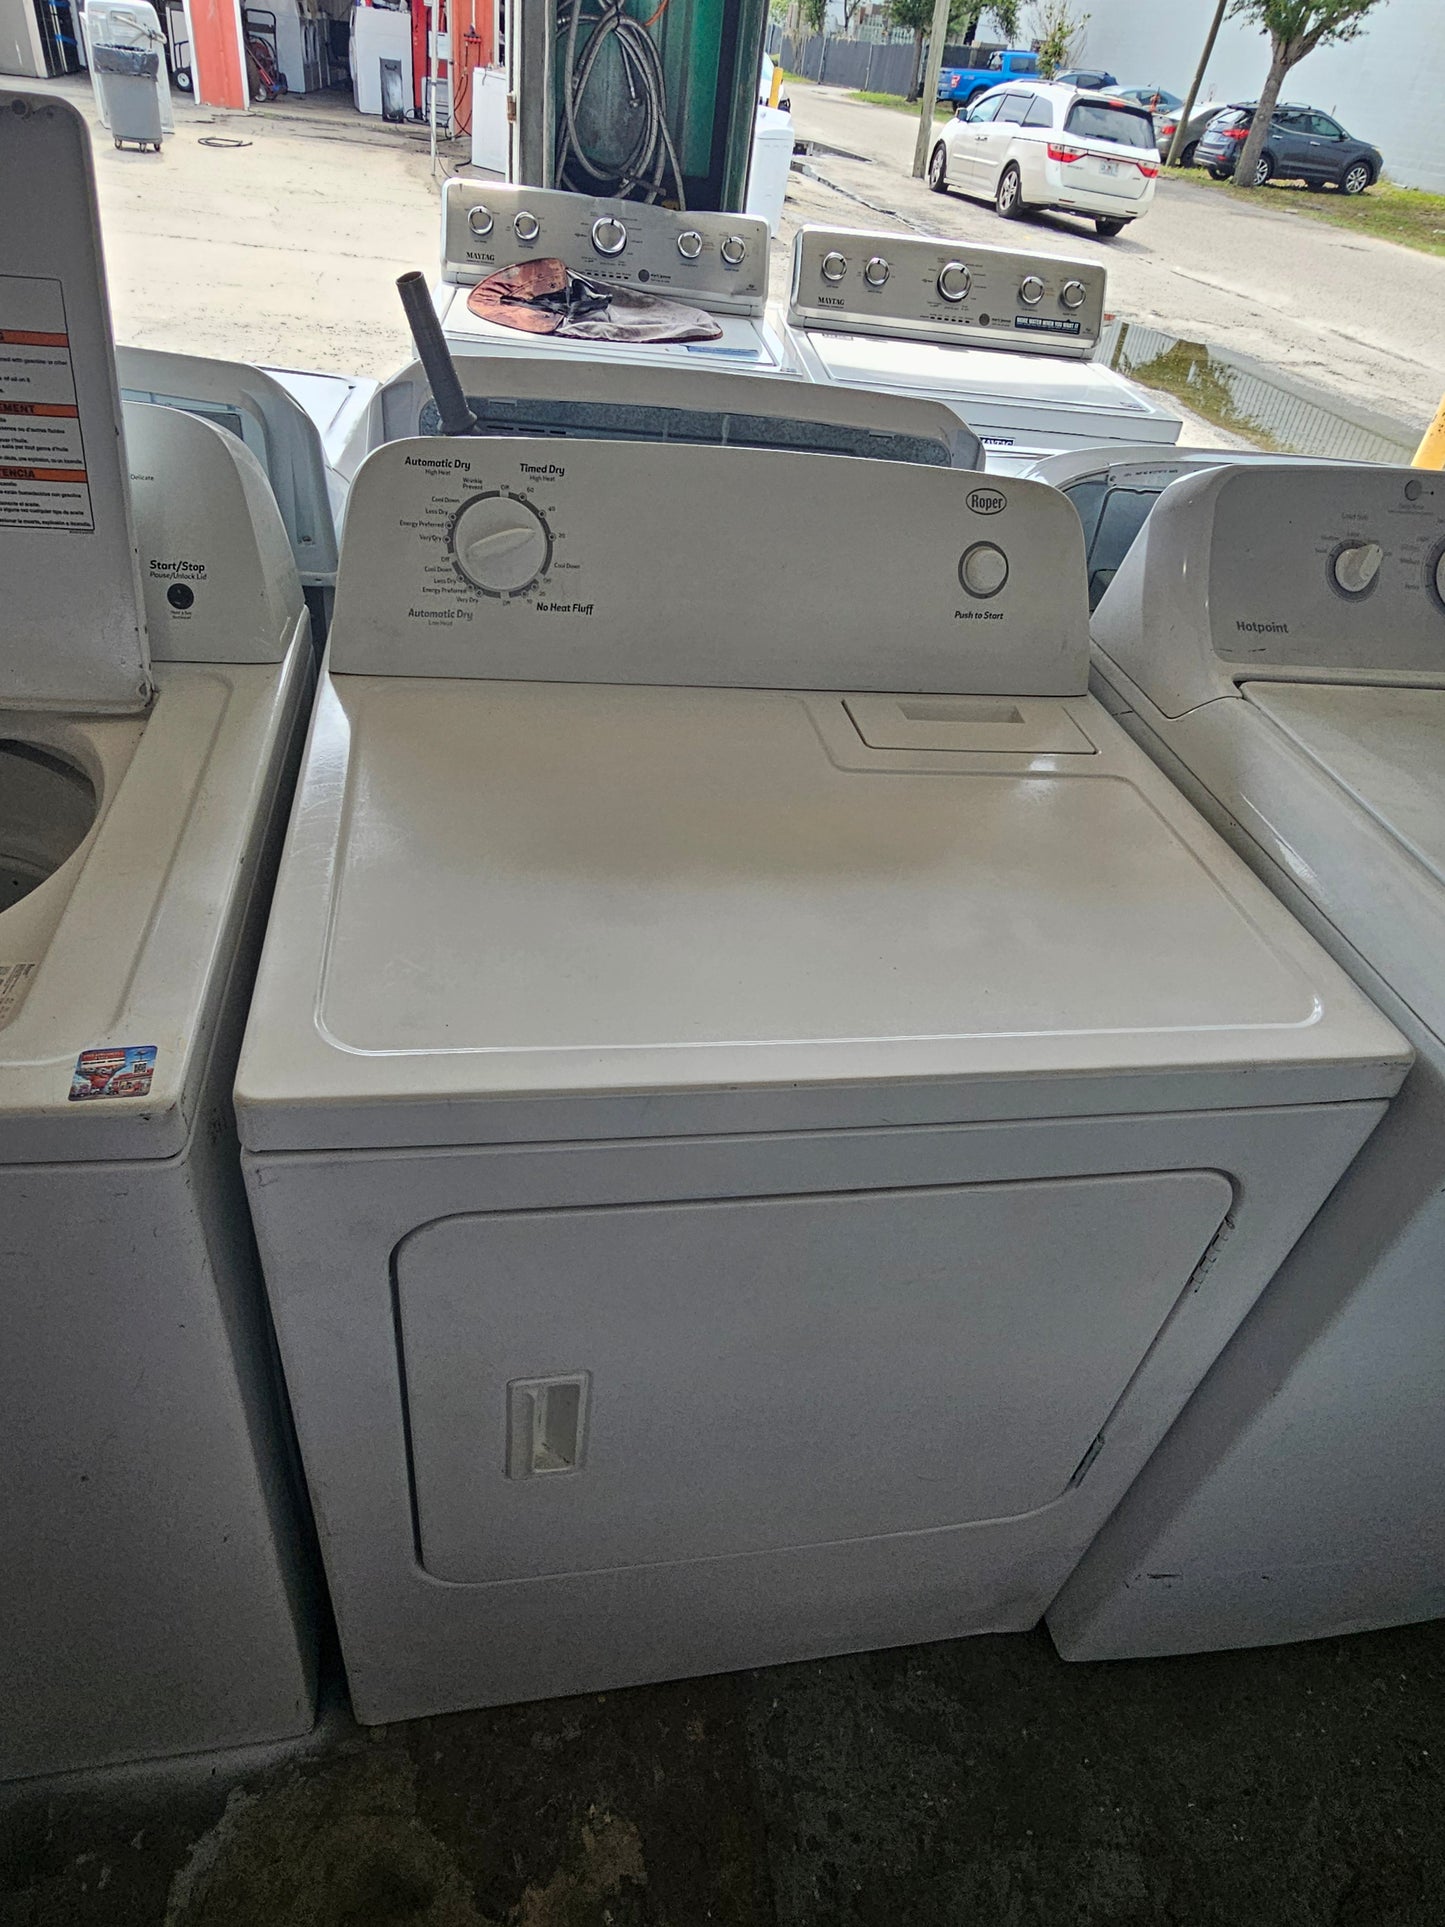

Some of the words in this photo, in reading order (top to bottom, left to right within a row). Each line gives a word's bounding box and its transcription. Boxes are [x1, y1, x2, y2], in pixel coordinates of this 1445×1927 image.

[466, 252, 494, 260] MAYTAG
[818, 297, 844, 305] MAYTAG
[405, 456, 452, 468] Automatic
[454, 459, 471, 471] Dry
[520, 463, 547, 473] Timed
[549, 465, 565, 477] Dry
[971, 494, 1003, 511] Roper
[149, 560, 205, 573] Start/Stop
[408, 608, 455, 618] Automatic
[457, 610, 473, 621] Dry
[537, 602, 548, 611] No
[551, 603, 570, 612] Heat
[572, 604, 594, 615] Fluff
[954, 611, 973, 619] Push
[984, 611, 1004, 620] Start
[1236, 621, 1289, 634] Hotpoint
